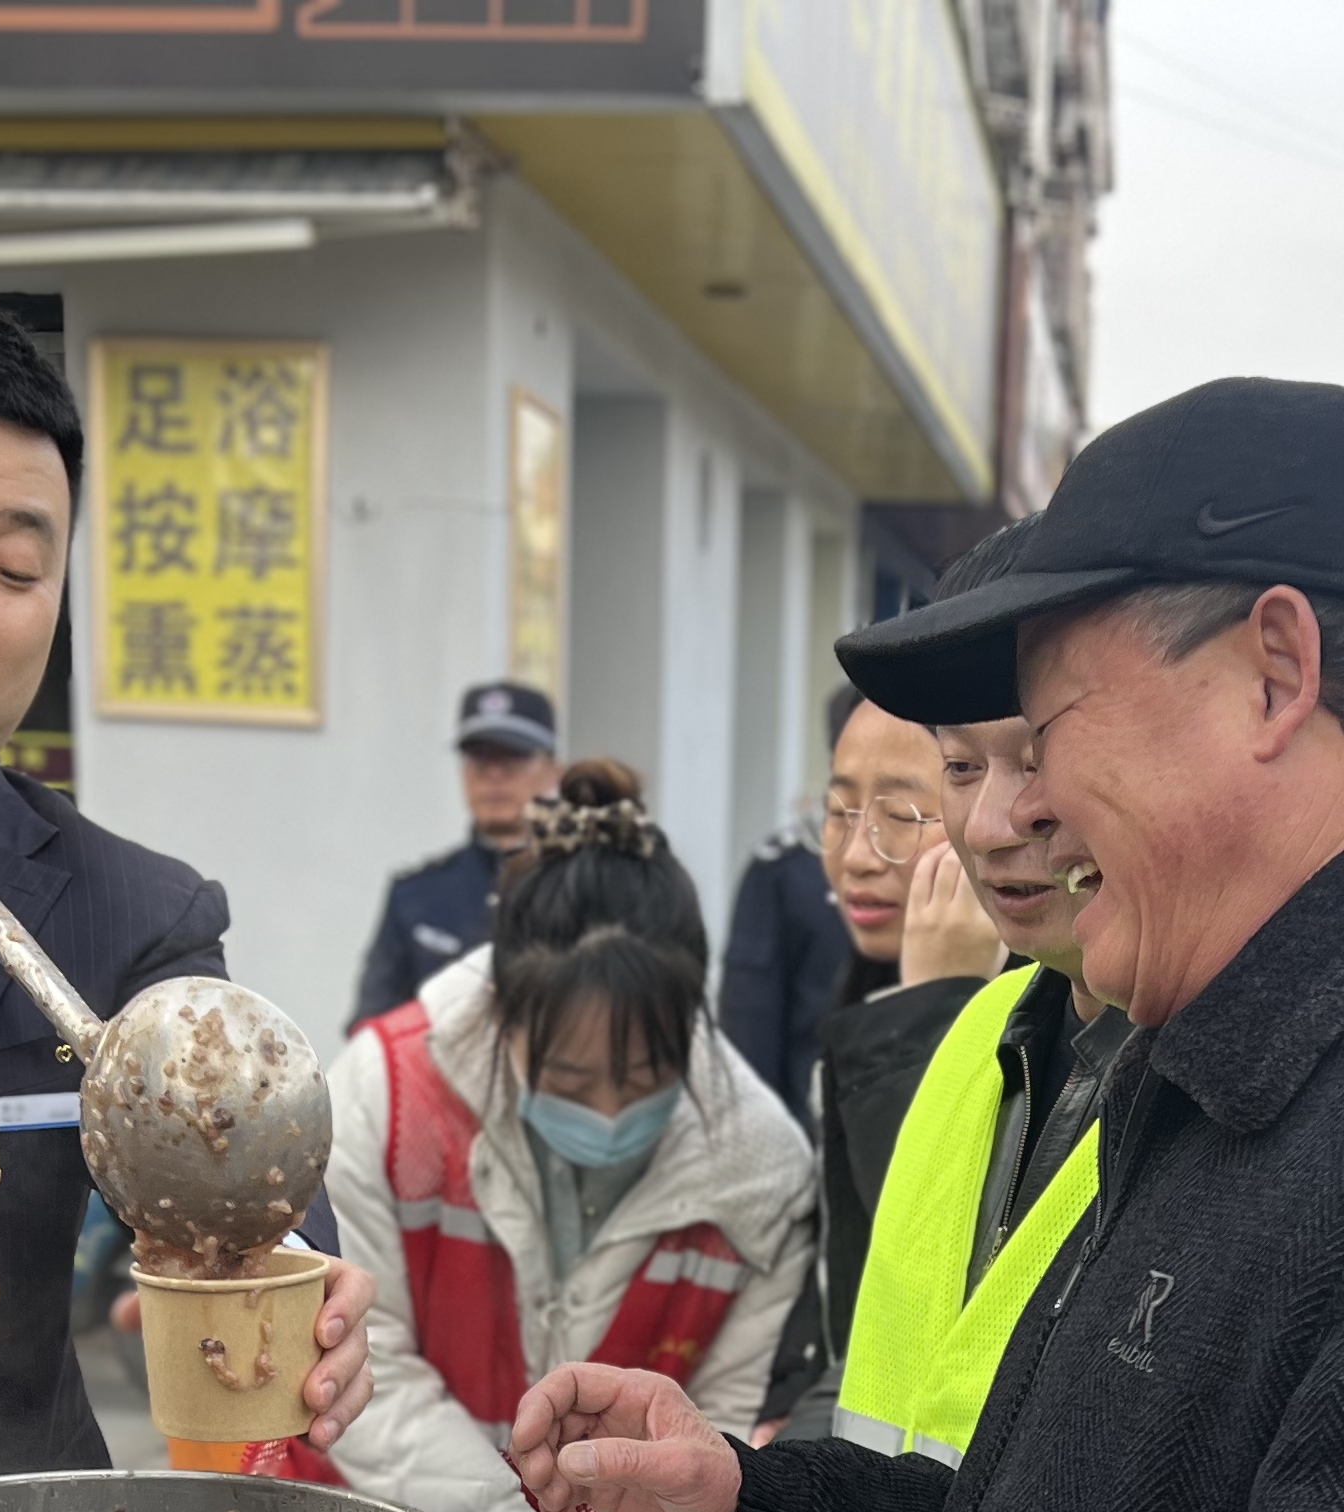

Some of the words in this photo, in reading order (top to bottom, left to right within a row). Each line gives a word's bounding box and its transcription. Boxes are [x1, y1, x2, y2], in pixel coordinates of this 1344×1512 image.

[116, 361, 299, 460] 足浴
[113, 482, 299, 577] 按摩
[116, 602, 299, 698] 熏蒸
